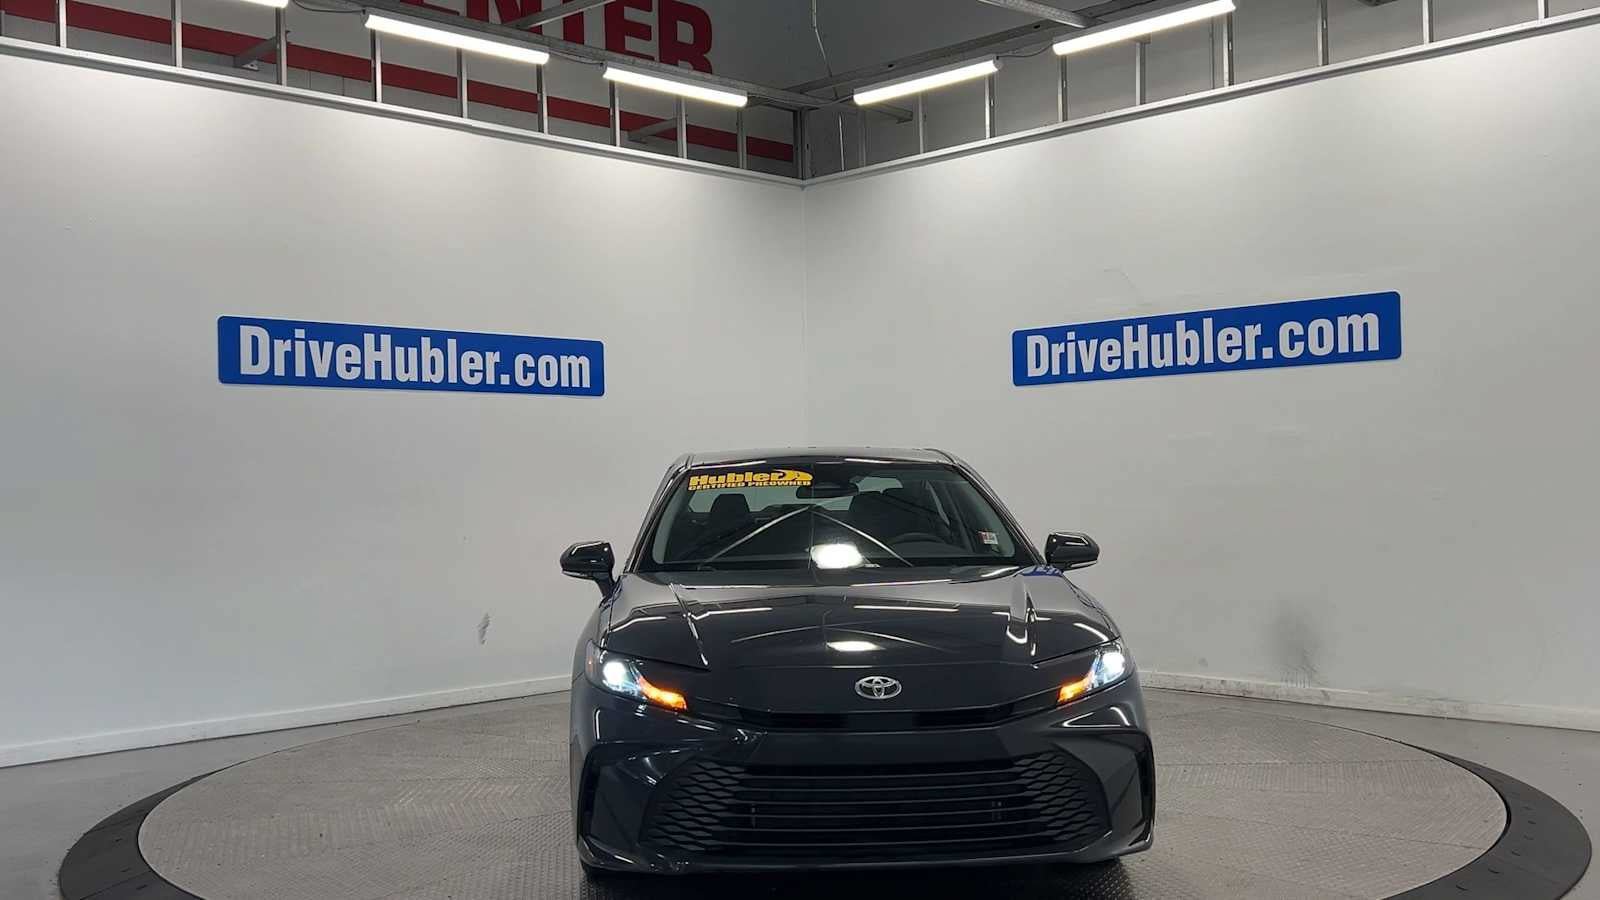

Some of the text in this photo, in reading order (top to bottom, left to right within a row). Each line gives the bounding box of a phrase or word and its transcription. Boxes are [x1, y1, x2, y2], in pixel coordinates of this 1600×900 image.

[402, 0, 713, 74] NER
[239, 324, 592, 389] DriveHubler.com
[1026, 312, 1380, 378] DriveHubler.com
[687, 481, 746, 491] CERTIFIED
[689, 470, 787, 486] Hubler
